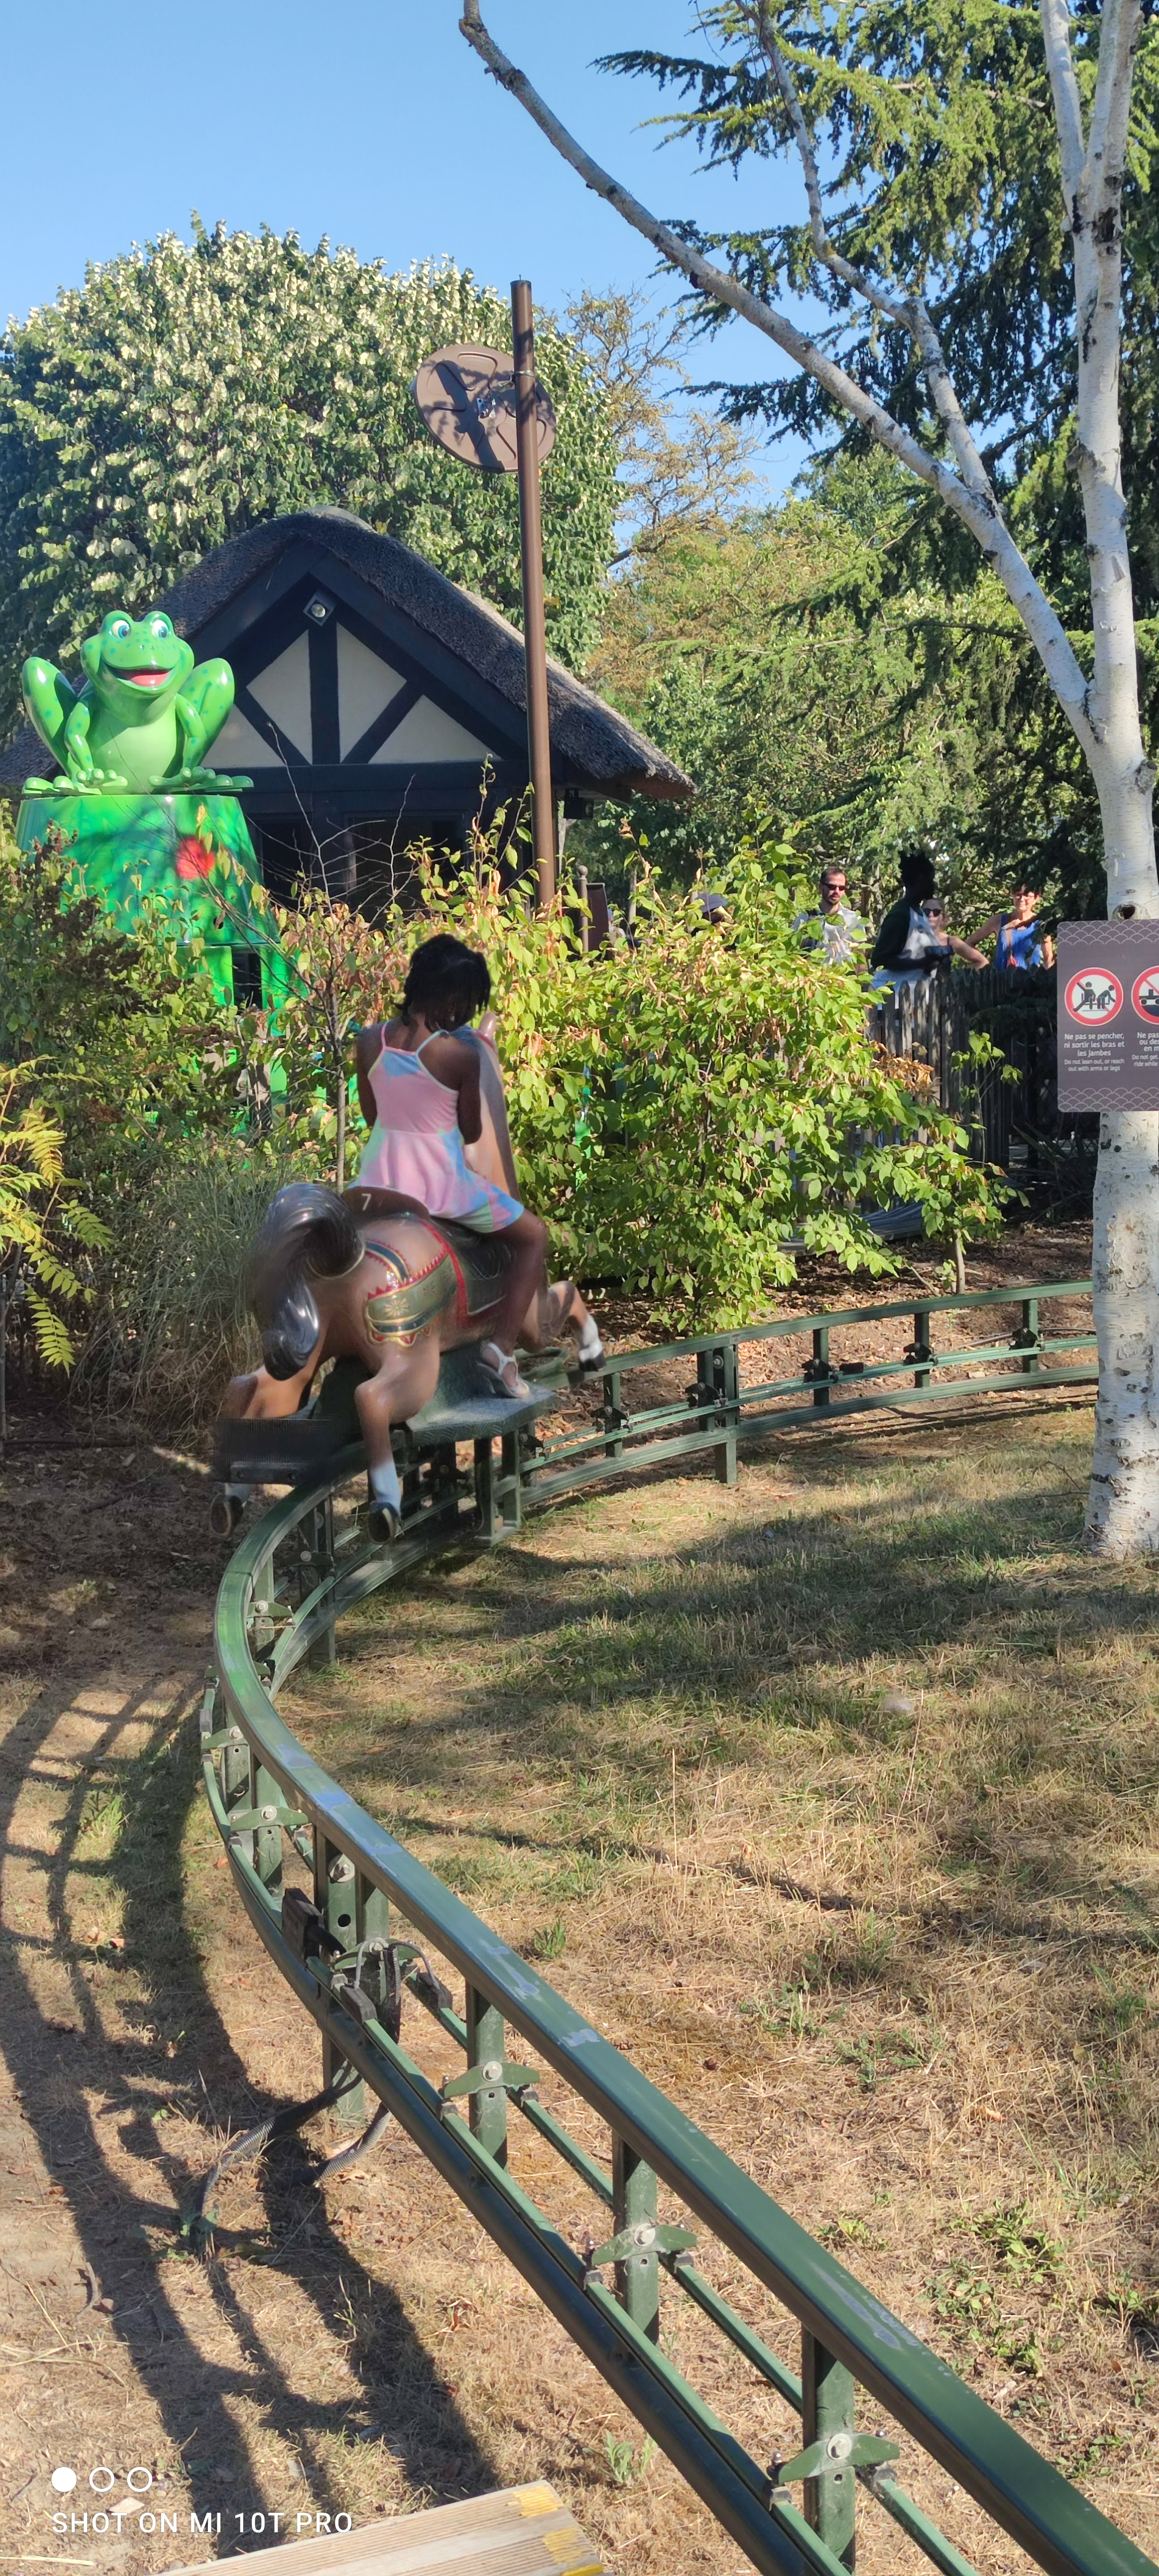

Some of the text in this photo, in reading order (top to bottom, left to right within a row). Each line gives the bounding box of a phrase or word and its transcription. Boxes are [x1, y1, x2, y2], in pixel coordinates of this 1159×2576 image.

[1097, 1032, 1124, 1041] pencher,
[1087, 1050, 1111, 1058] jambes
[361, 1193, 372, 1211] 7
